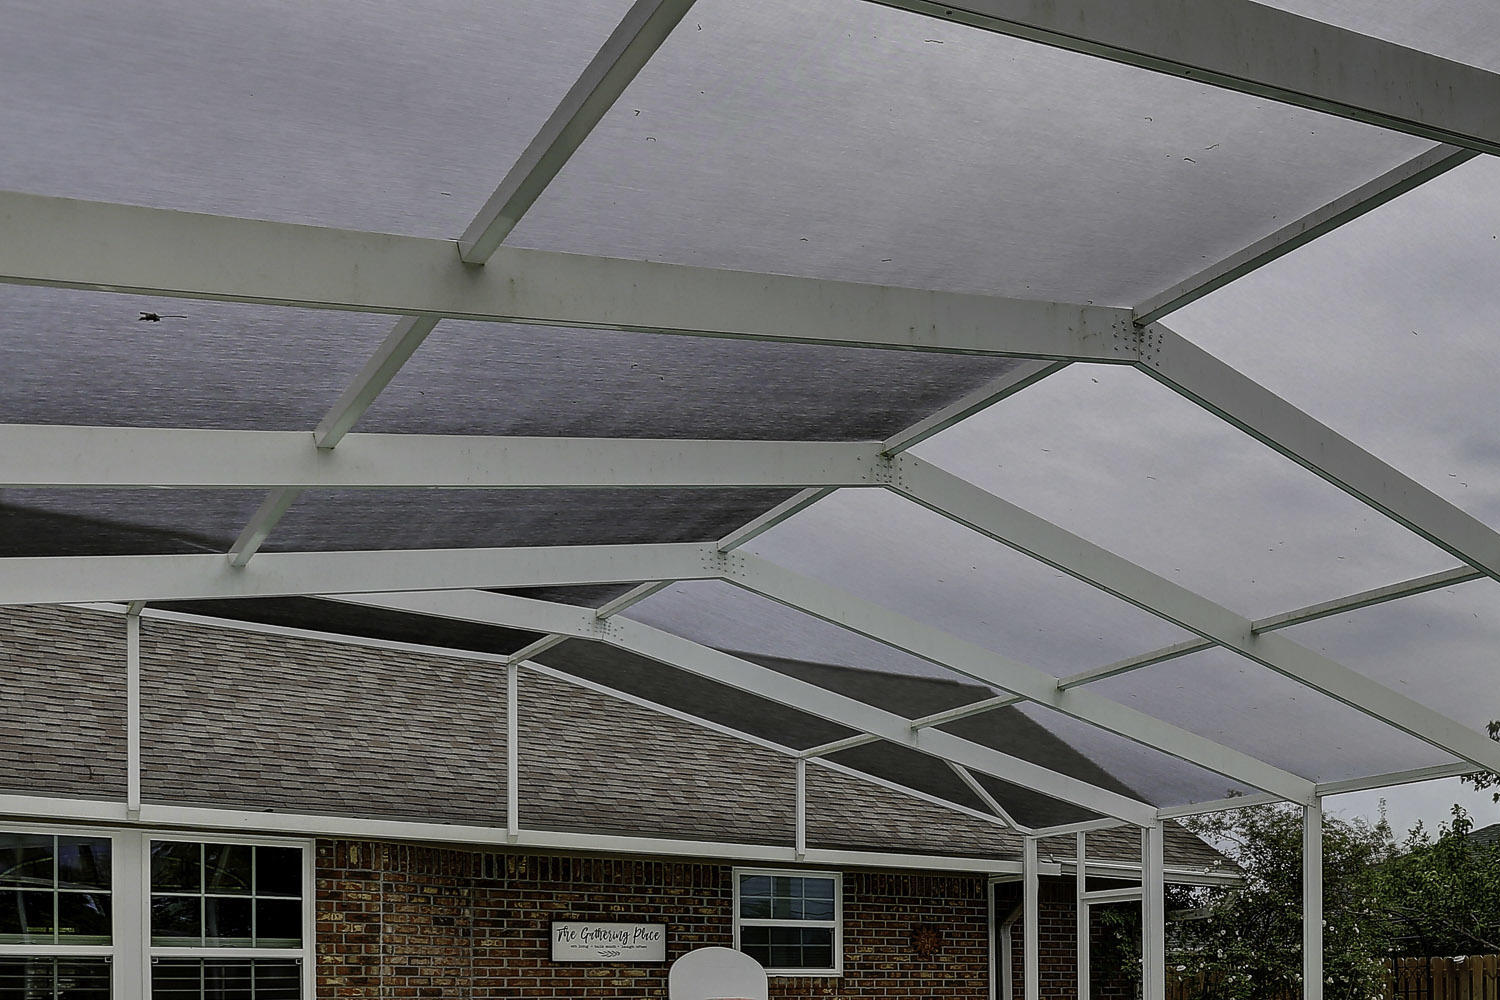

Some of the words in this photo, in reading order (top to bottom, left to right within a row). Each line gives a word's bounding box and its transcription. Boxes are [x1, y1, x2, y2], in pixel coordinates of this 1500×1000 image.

[557, 925, 576, 942] The
[581, 926, 630, 945] Gathering
[633, 926, 660, 944] Place
